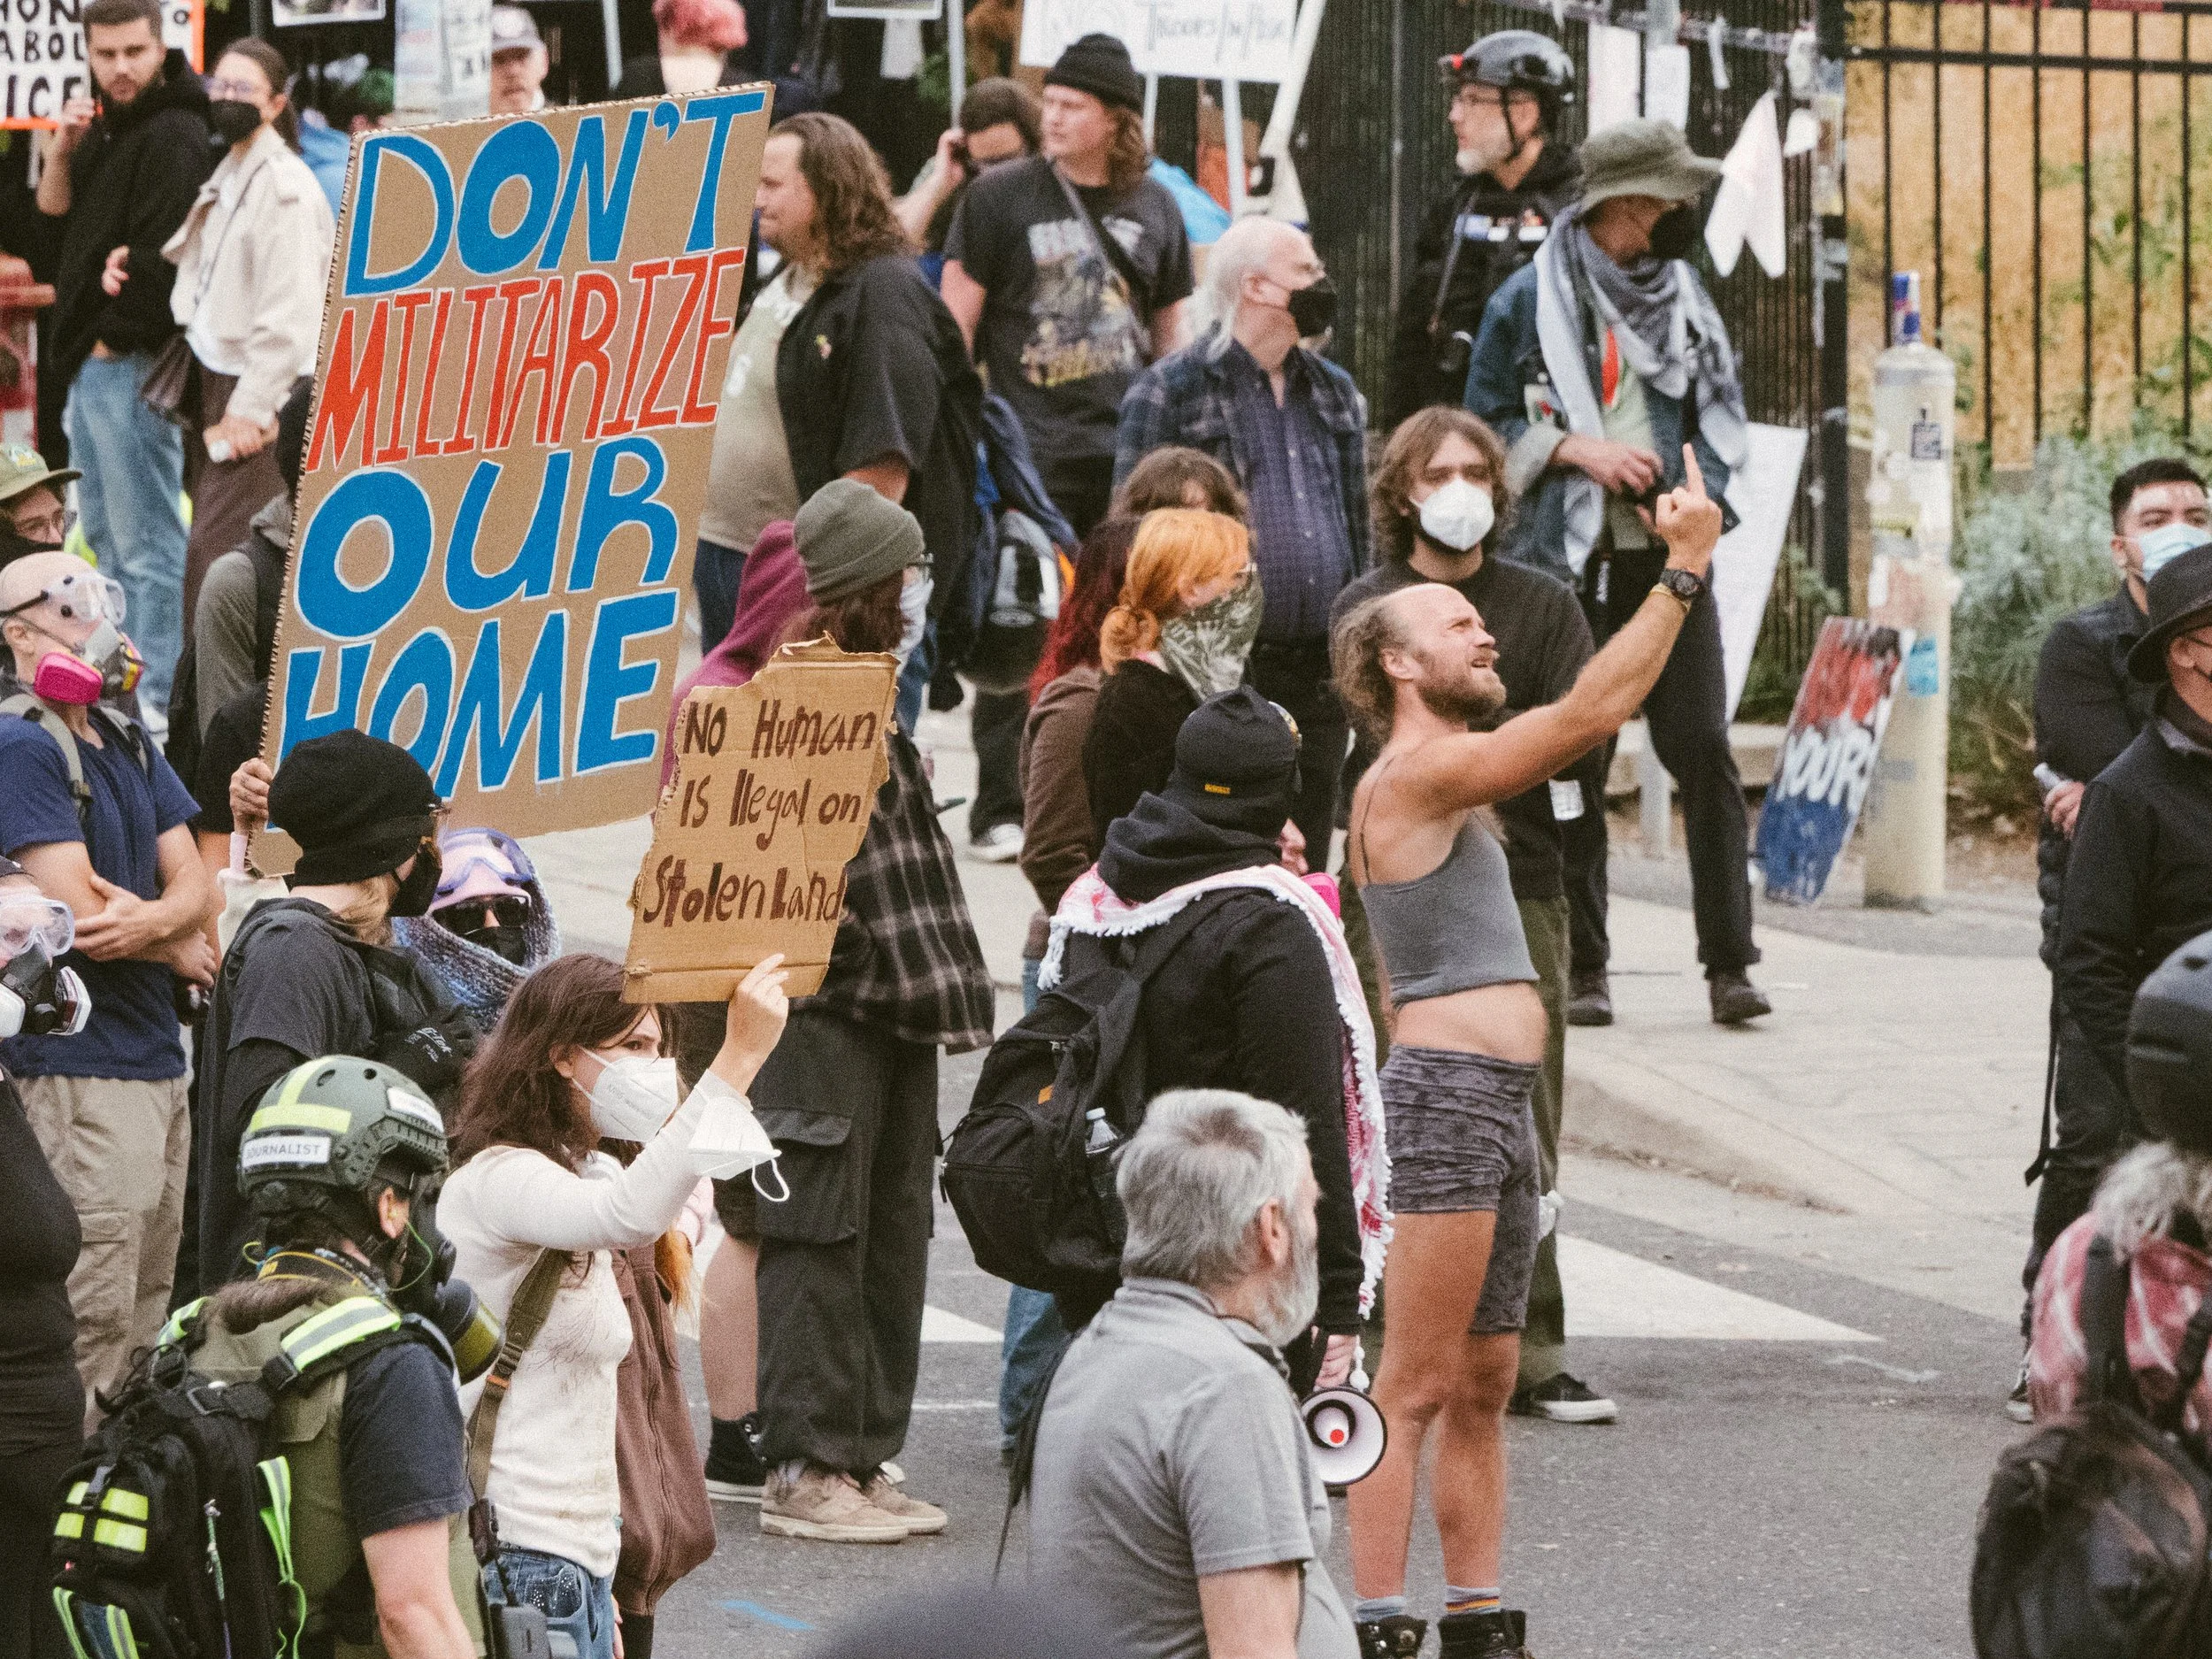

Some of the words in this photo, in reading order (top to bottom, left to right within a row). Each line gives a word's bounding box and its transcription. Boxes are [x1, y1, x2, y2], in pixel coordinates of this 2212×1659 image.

[343, 92, 765, 296] DON'T
[305, 248, 745, 472] MILITARIZE
[297, 436, 678, 638] OUR
[265, 592, 677, 832] HOME
[683, 701, 726, 757] NO
[751, 699, 877, 759] Human
[818, 792, 862, 826] on
[643, 855, 765, 927] Stolen
[770, 866, 847, 921] Land
